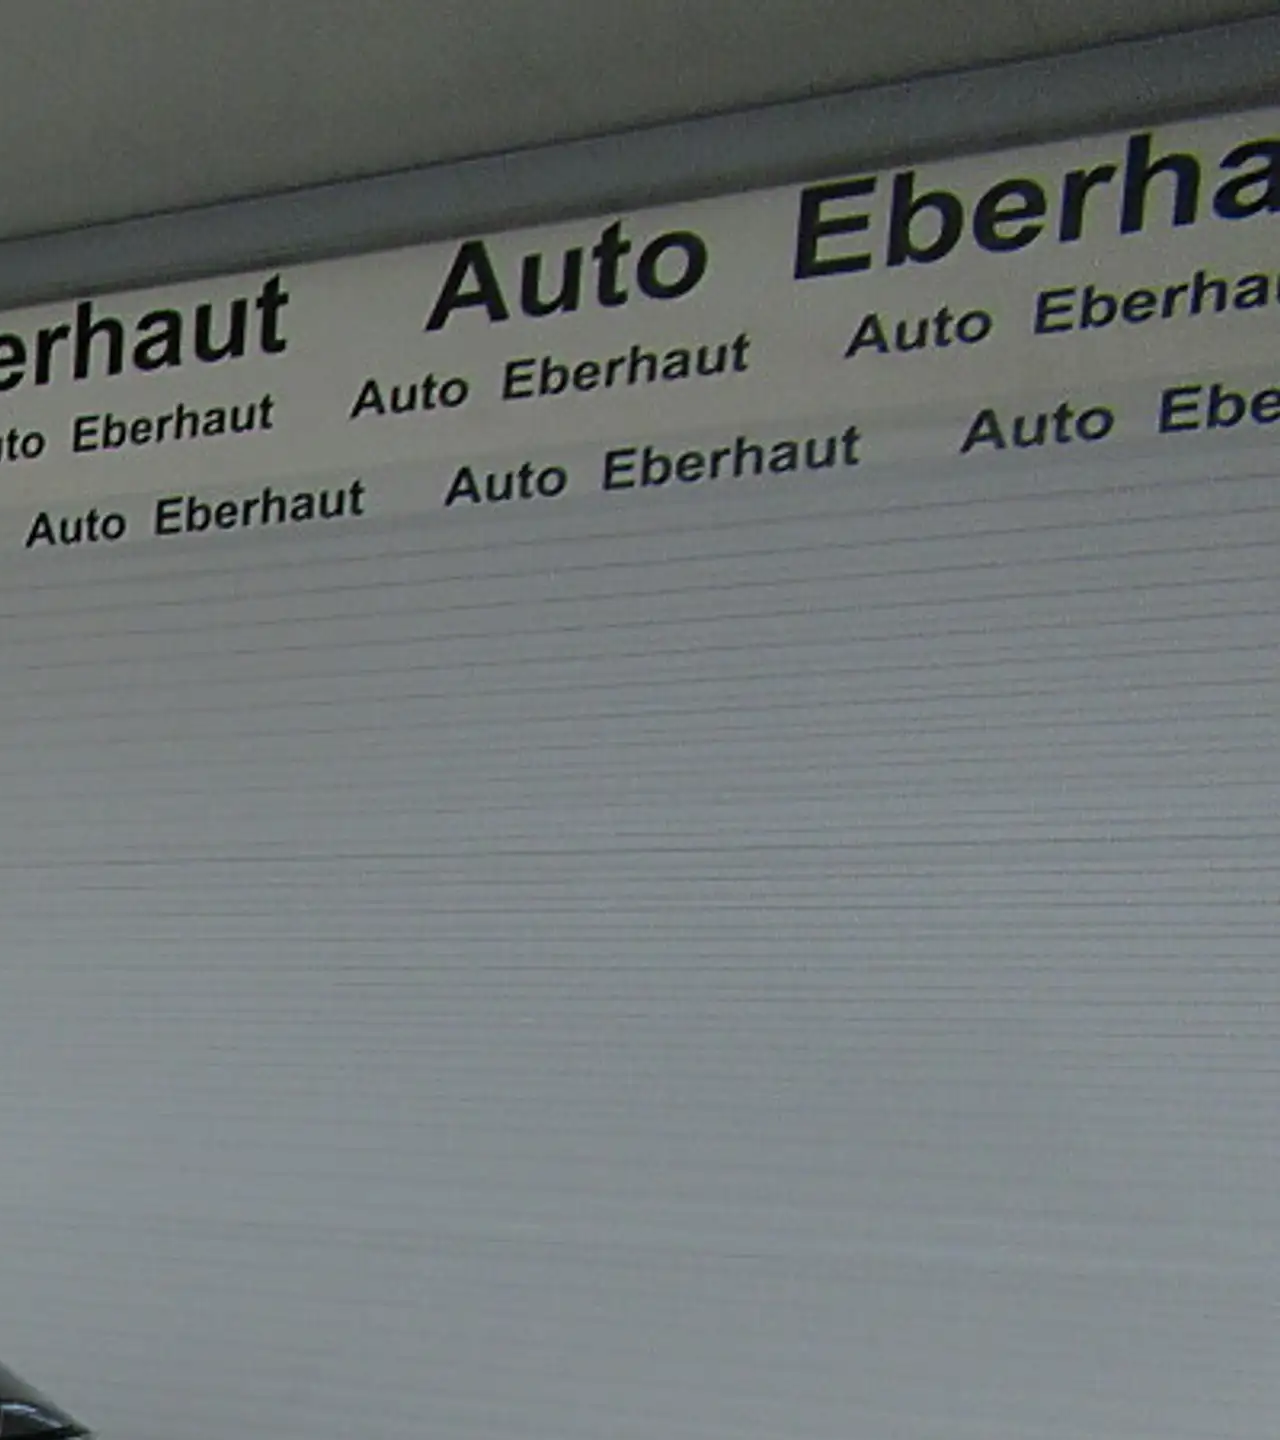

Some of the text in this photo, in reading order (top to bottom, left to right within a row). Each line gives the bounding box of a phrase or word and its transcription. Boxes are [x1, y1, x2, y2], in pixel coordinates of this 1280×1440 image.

[425, 220, 707, 331] Auto
[845, 307, 992, 358] Auto
[351, 334, 750, 418] Auto Eberhaut
[73, 395, 273, 452] Eberhaut
[961, 403, 1114, 453] Auto
[445, 426, 860, 506] Auto Eberhaut
[26, 480, 364, 548] Auto Eberhaut
